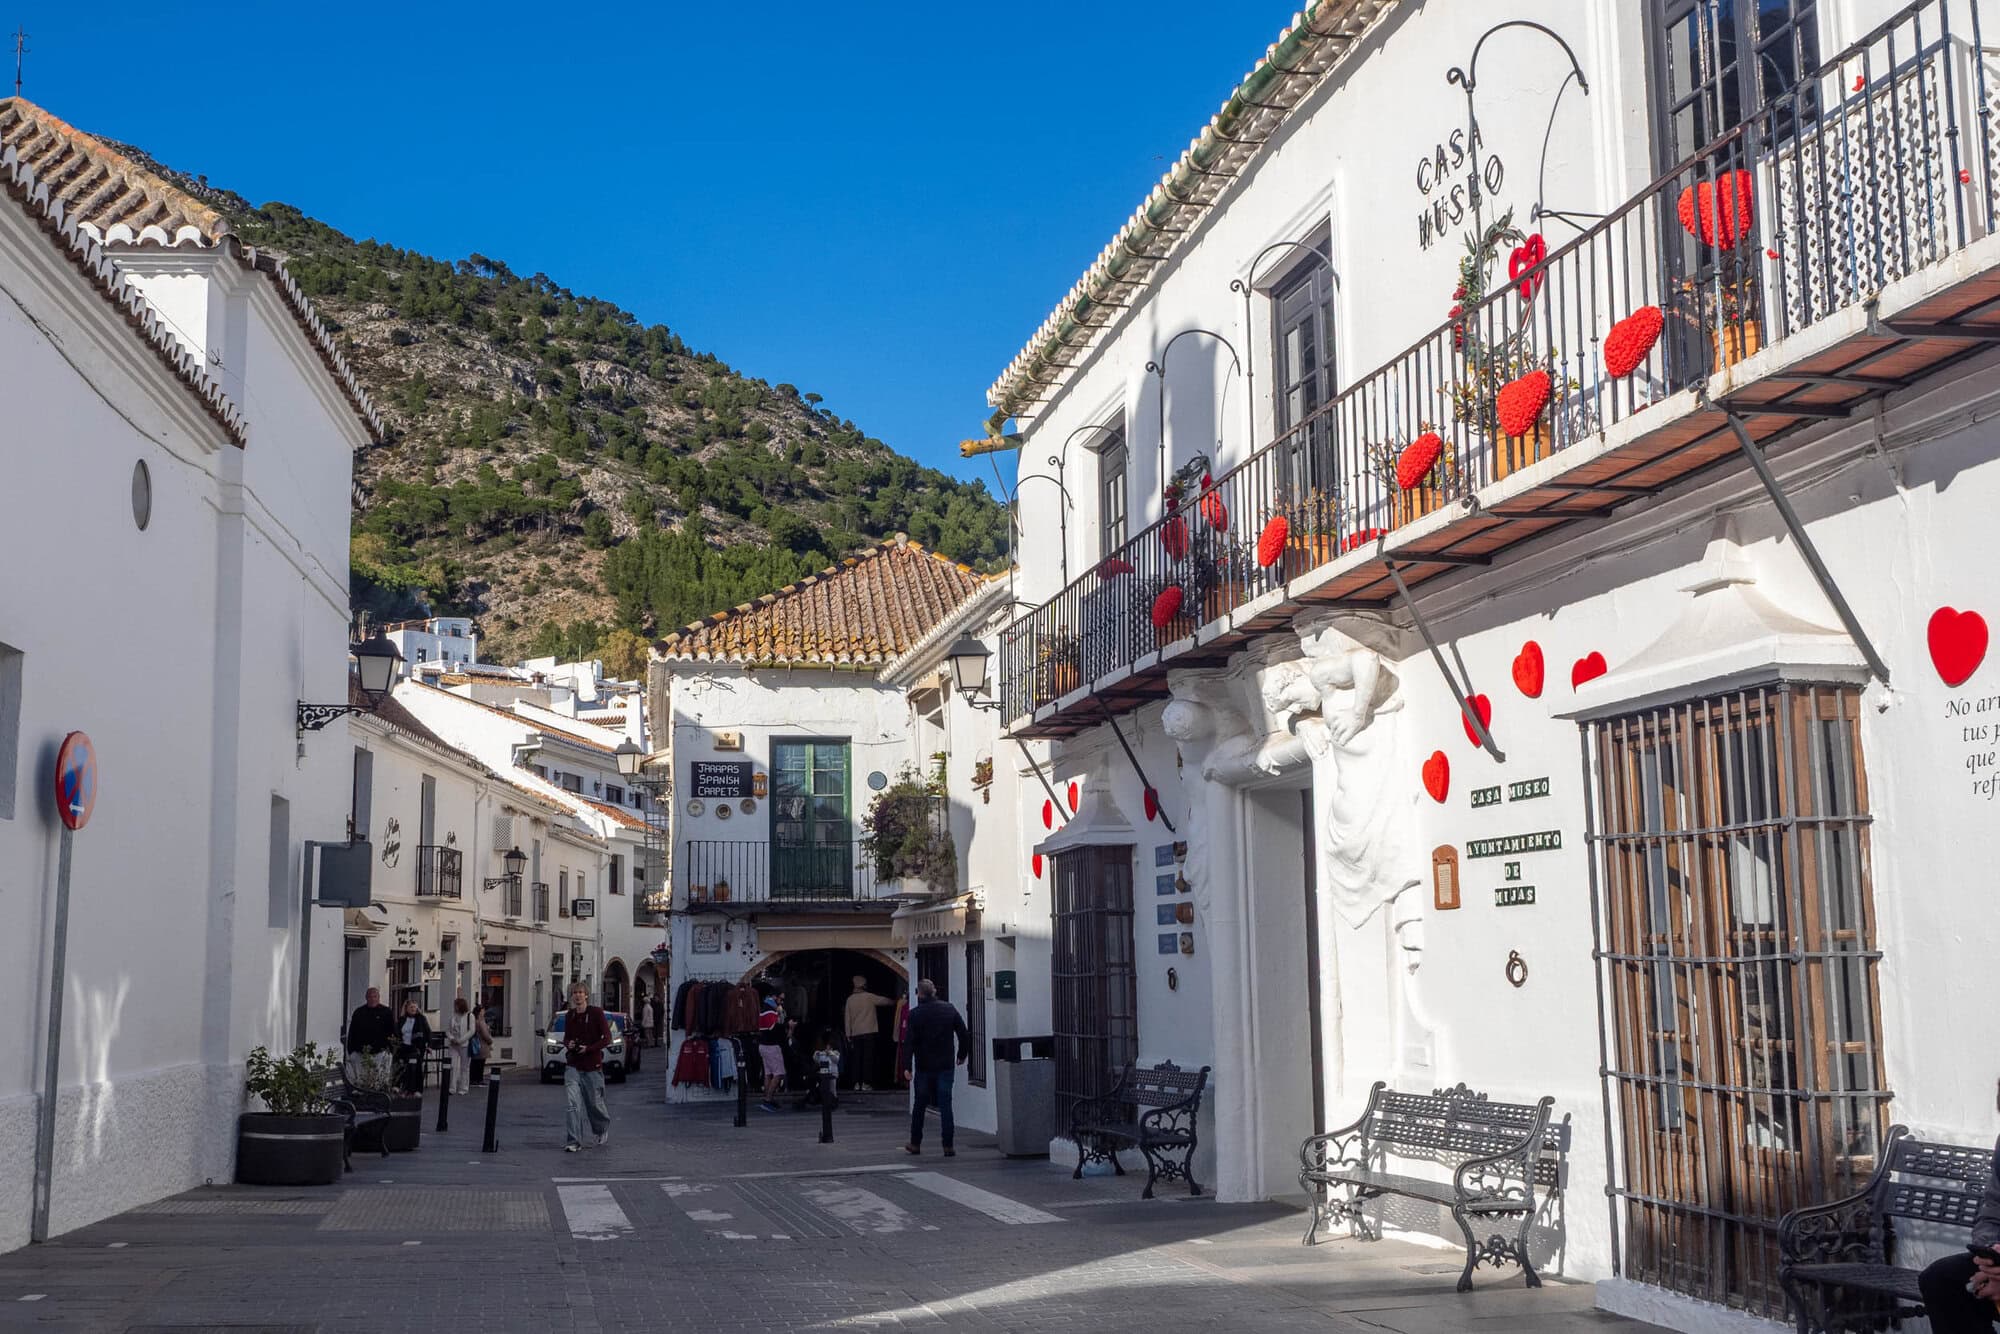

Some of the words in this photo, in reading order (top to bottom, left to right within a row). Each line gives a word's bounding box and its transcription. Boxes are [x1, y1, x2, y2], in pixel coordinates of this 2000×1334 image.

[1417, 118, 1483, 195] CASA
[1945, 698, 1970, 718] No
[1963, 726, 1988, 742] tus
[1966, 751, 1996, 774] que
[698, 786, 740, 796] CARPETS
[1471, 788, 1501, 806] CASA
[1509, 780, 1548, 800] MUSEO
[1973, 771, 2000, 800] ref
[1467, 833, 1560, 856] AYUNTAMIENTO
[1504, 864, 1520, 878] DE
[1495, 888, 1534, 904] MIJAS
